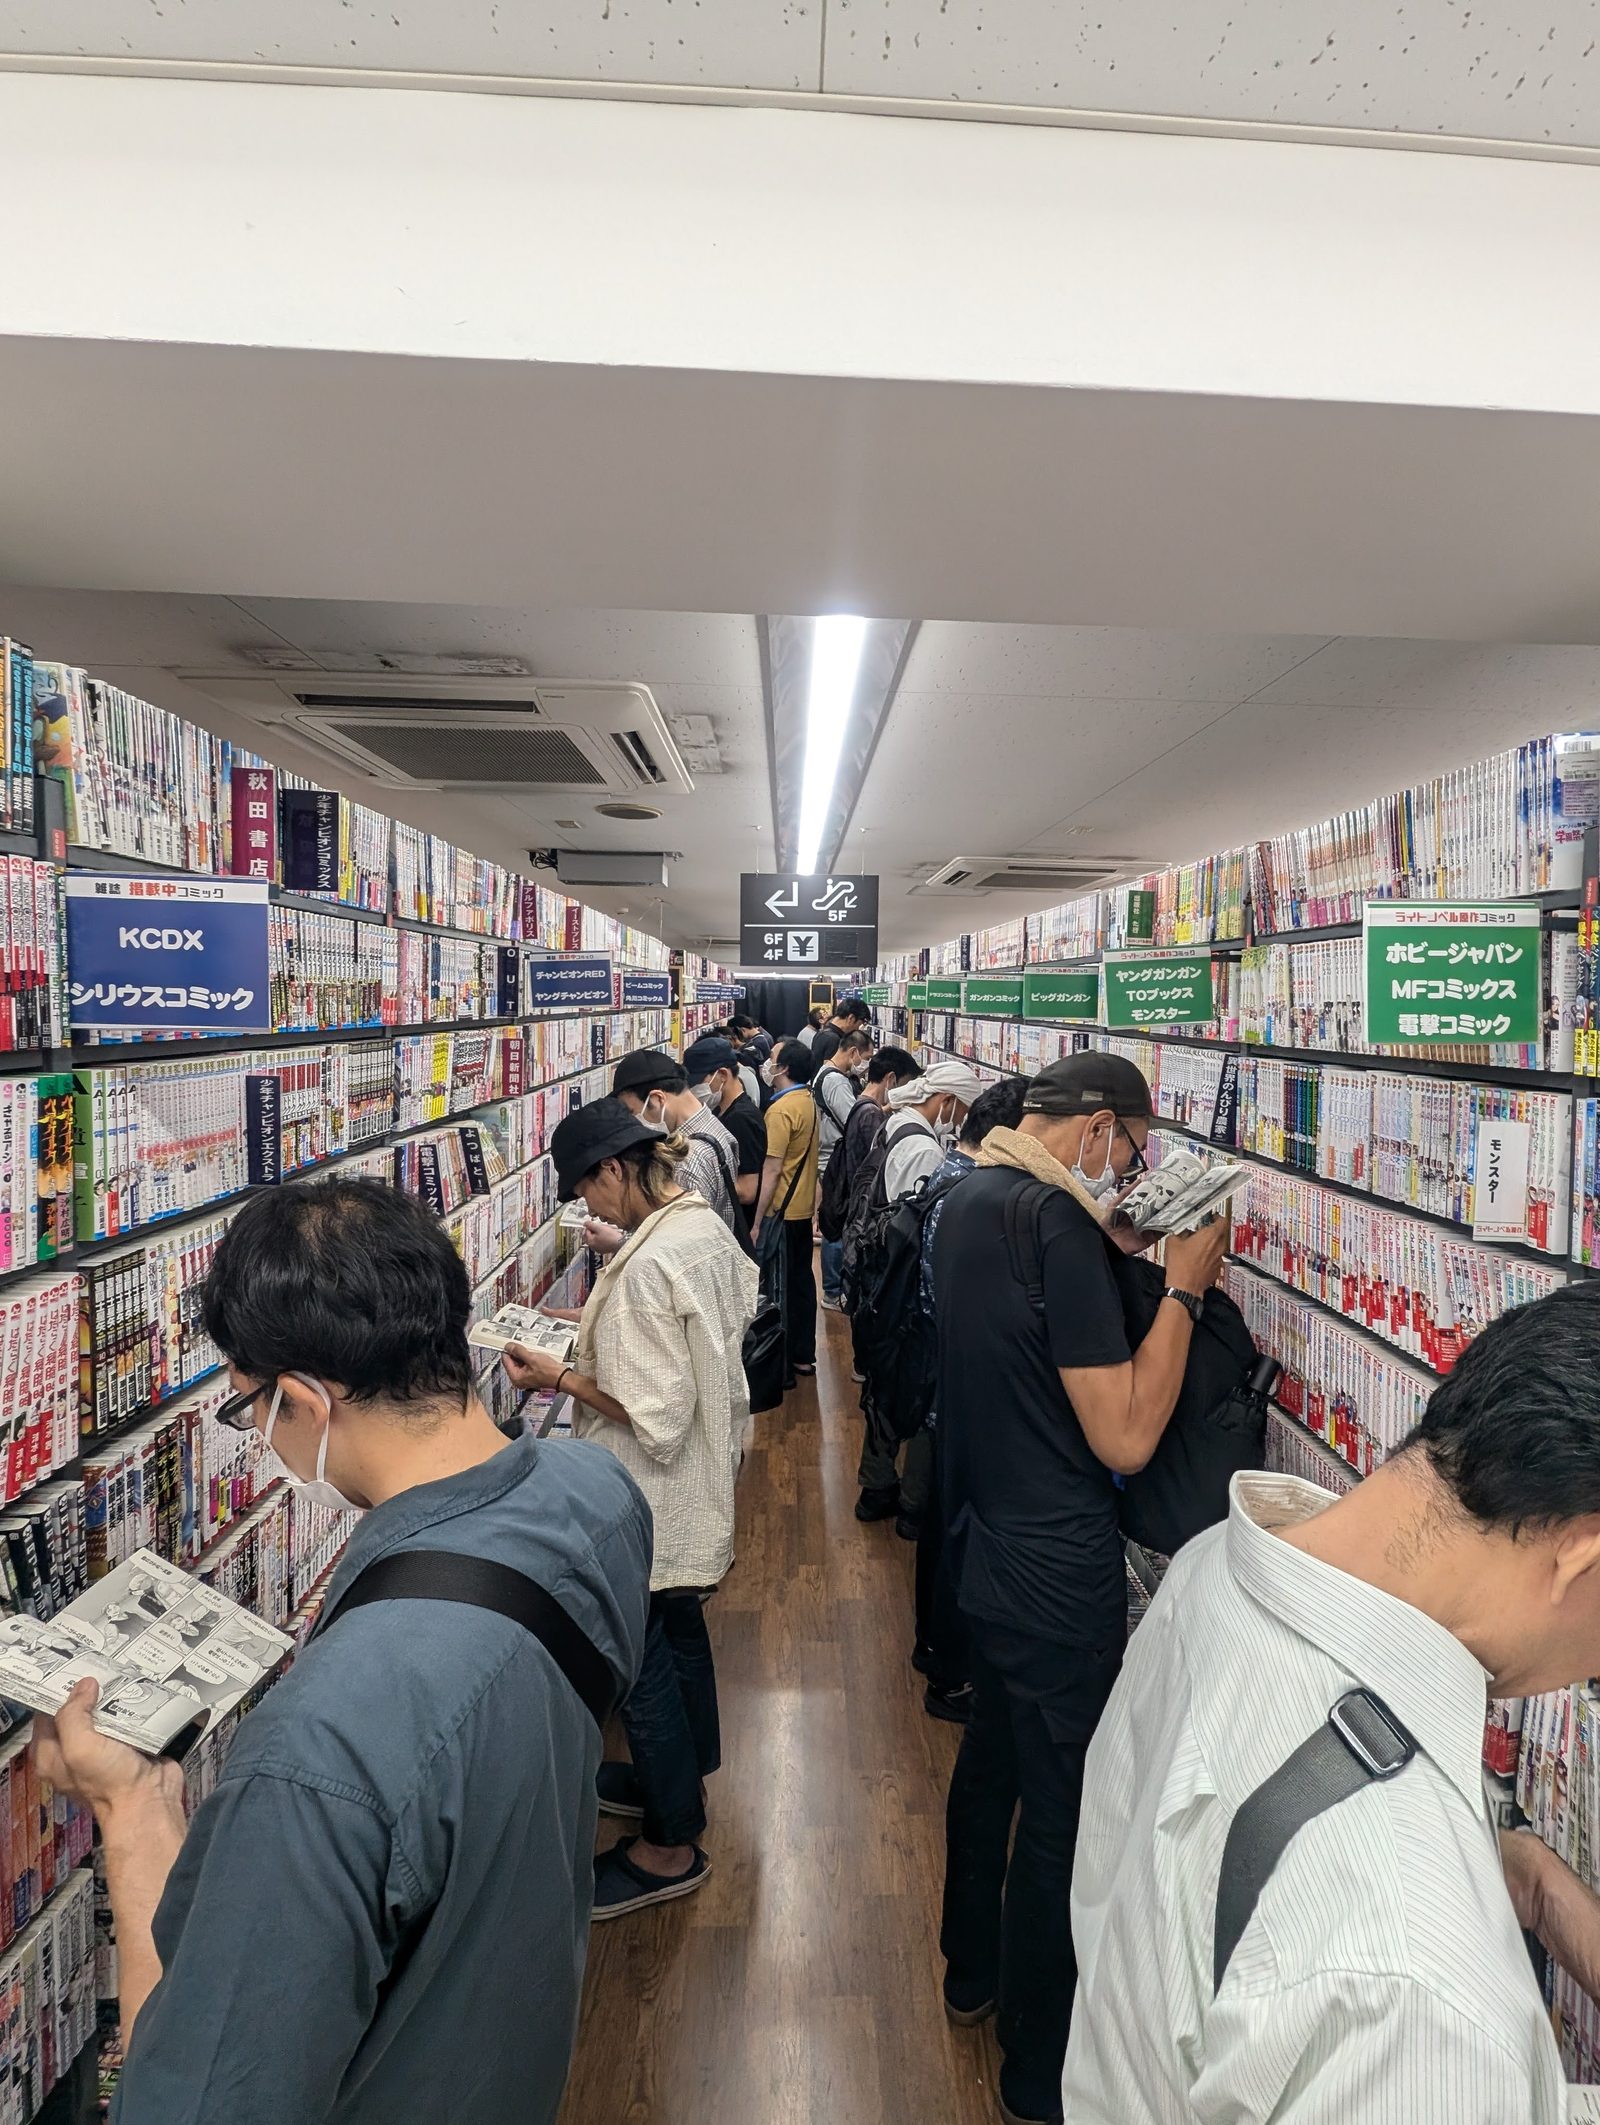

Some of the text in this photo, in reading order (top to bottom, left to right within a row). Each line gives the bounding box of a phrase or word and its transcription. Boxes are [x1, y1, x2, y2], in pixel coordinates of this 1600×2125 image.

[248, 773, 267, 876] 秋田書店
[316, 794, 331, 888] 少年チャンピオンコミックス
[95, 883, 121, 894] 雑誌
[524, 886, 535, 938] アルファポリス
[828, 910, 847, 922] 5F
[1395, 912, 1516, 923] ライトノベル原作コミック
[119, 927, 204, 951] KCDX
[763, 932, 783, 945] 6F
[763, 948, 783, 961] 4F
[1386, 942, 1523, 964] ホビージャパン
[506, 949, 515, 1010] OUT
[536, 969, 606, 980] チャンピオンRED
[1116, 967, 1201, 982] ヤングガンガン
[70, 984, 255, 1010] シリウスコミック
[535, 990, 609, 1002] ヤングチャンピオン
[969, 993, 1020, 1004] ガンガンコミック
[1030, 992, 1091, 1004] ビッグガンガン
[1126, 988, 1195, 1003] TOブックス
[1392, 980, 1516, 999] MFコミックス
[1131, 1008, 1190, 1021] モンスター
[1399, 1014, 1511, 1036] 電撃コミック
[509, 1040, 519, 1095] 朝日新聞社
[1214, 1057, 1238, 1135] 異世界のんびり農家
[260, 1079, 274, 1182] 少年チャンピオンエクストラ
[1488, 1139, 1501, 1204] モンスター
[33, 1316, 47, 1387] はたらく細胞
[46, 1310, 58, 1380] はたらく細胞
[3, 1328, 19, 1403] はたらく細胞
[19, 1322, 34, 1395] はたらく細胞
